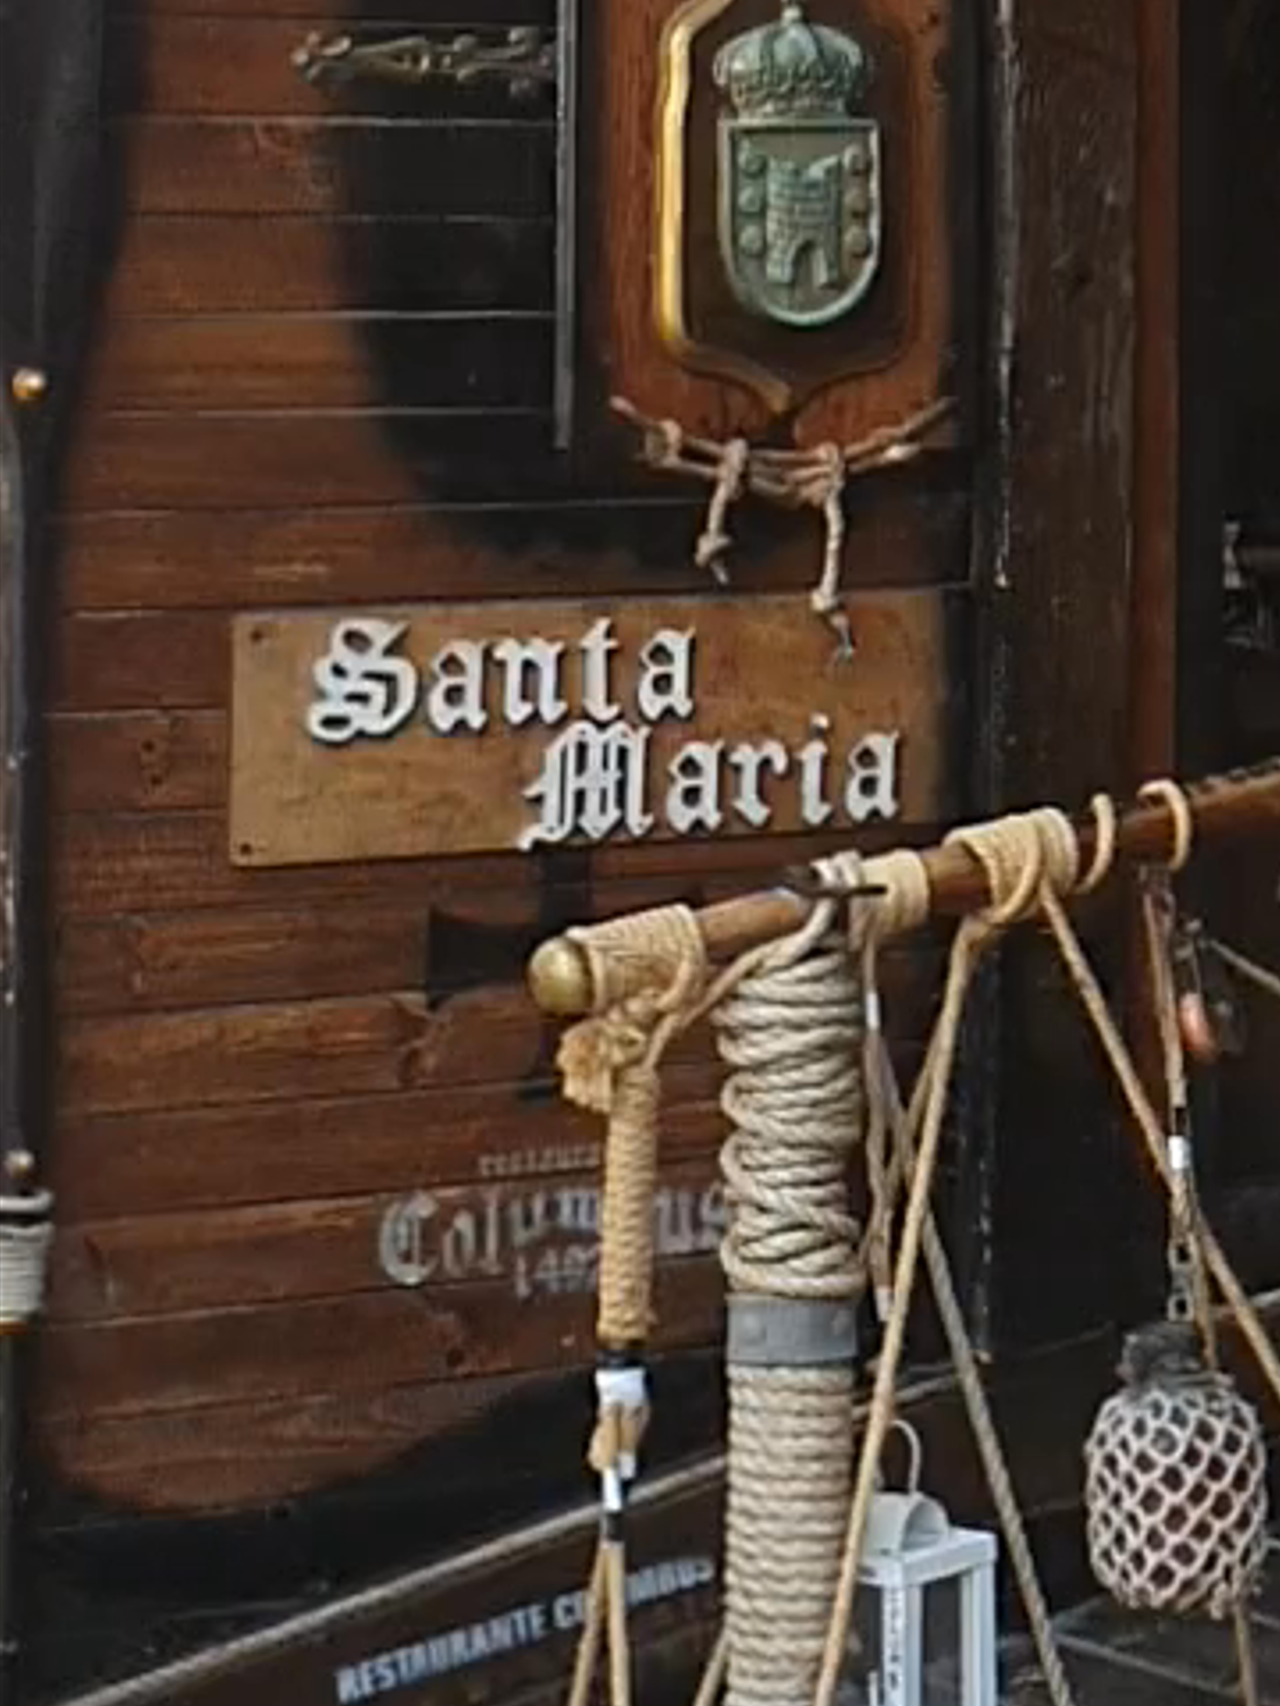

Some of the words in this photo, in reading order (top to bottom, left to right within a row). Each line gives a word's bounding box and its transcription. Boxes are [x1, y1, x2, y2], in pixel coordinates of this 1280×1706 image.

[306, 616, 697, 744] Santa
[516, 711, 901, 853] Maria
[379, 1180, 730, 1287] Columus
[335, 1602, 548, 1706] RESTAURANTE
